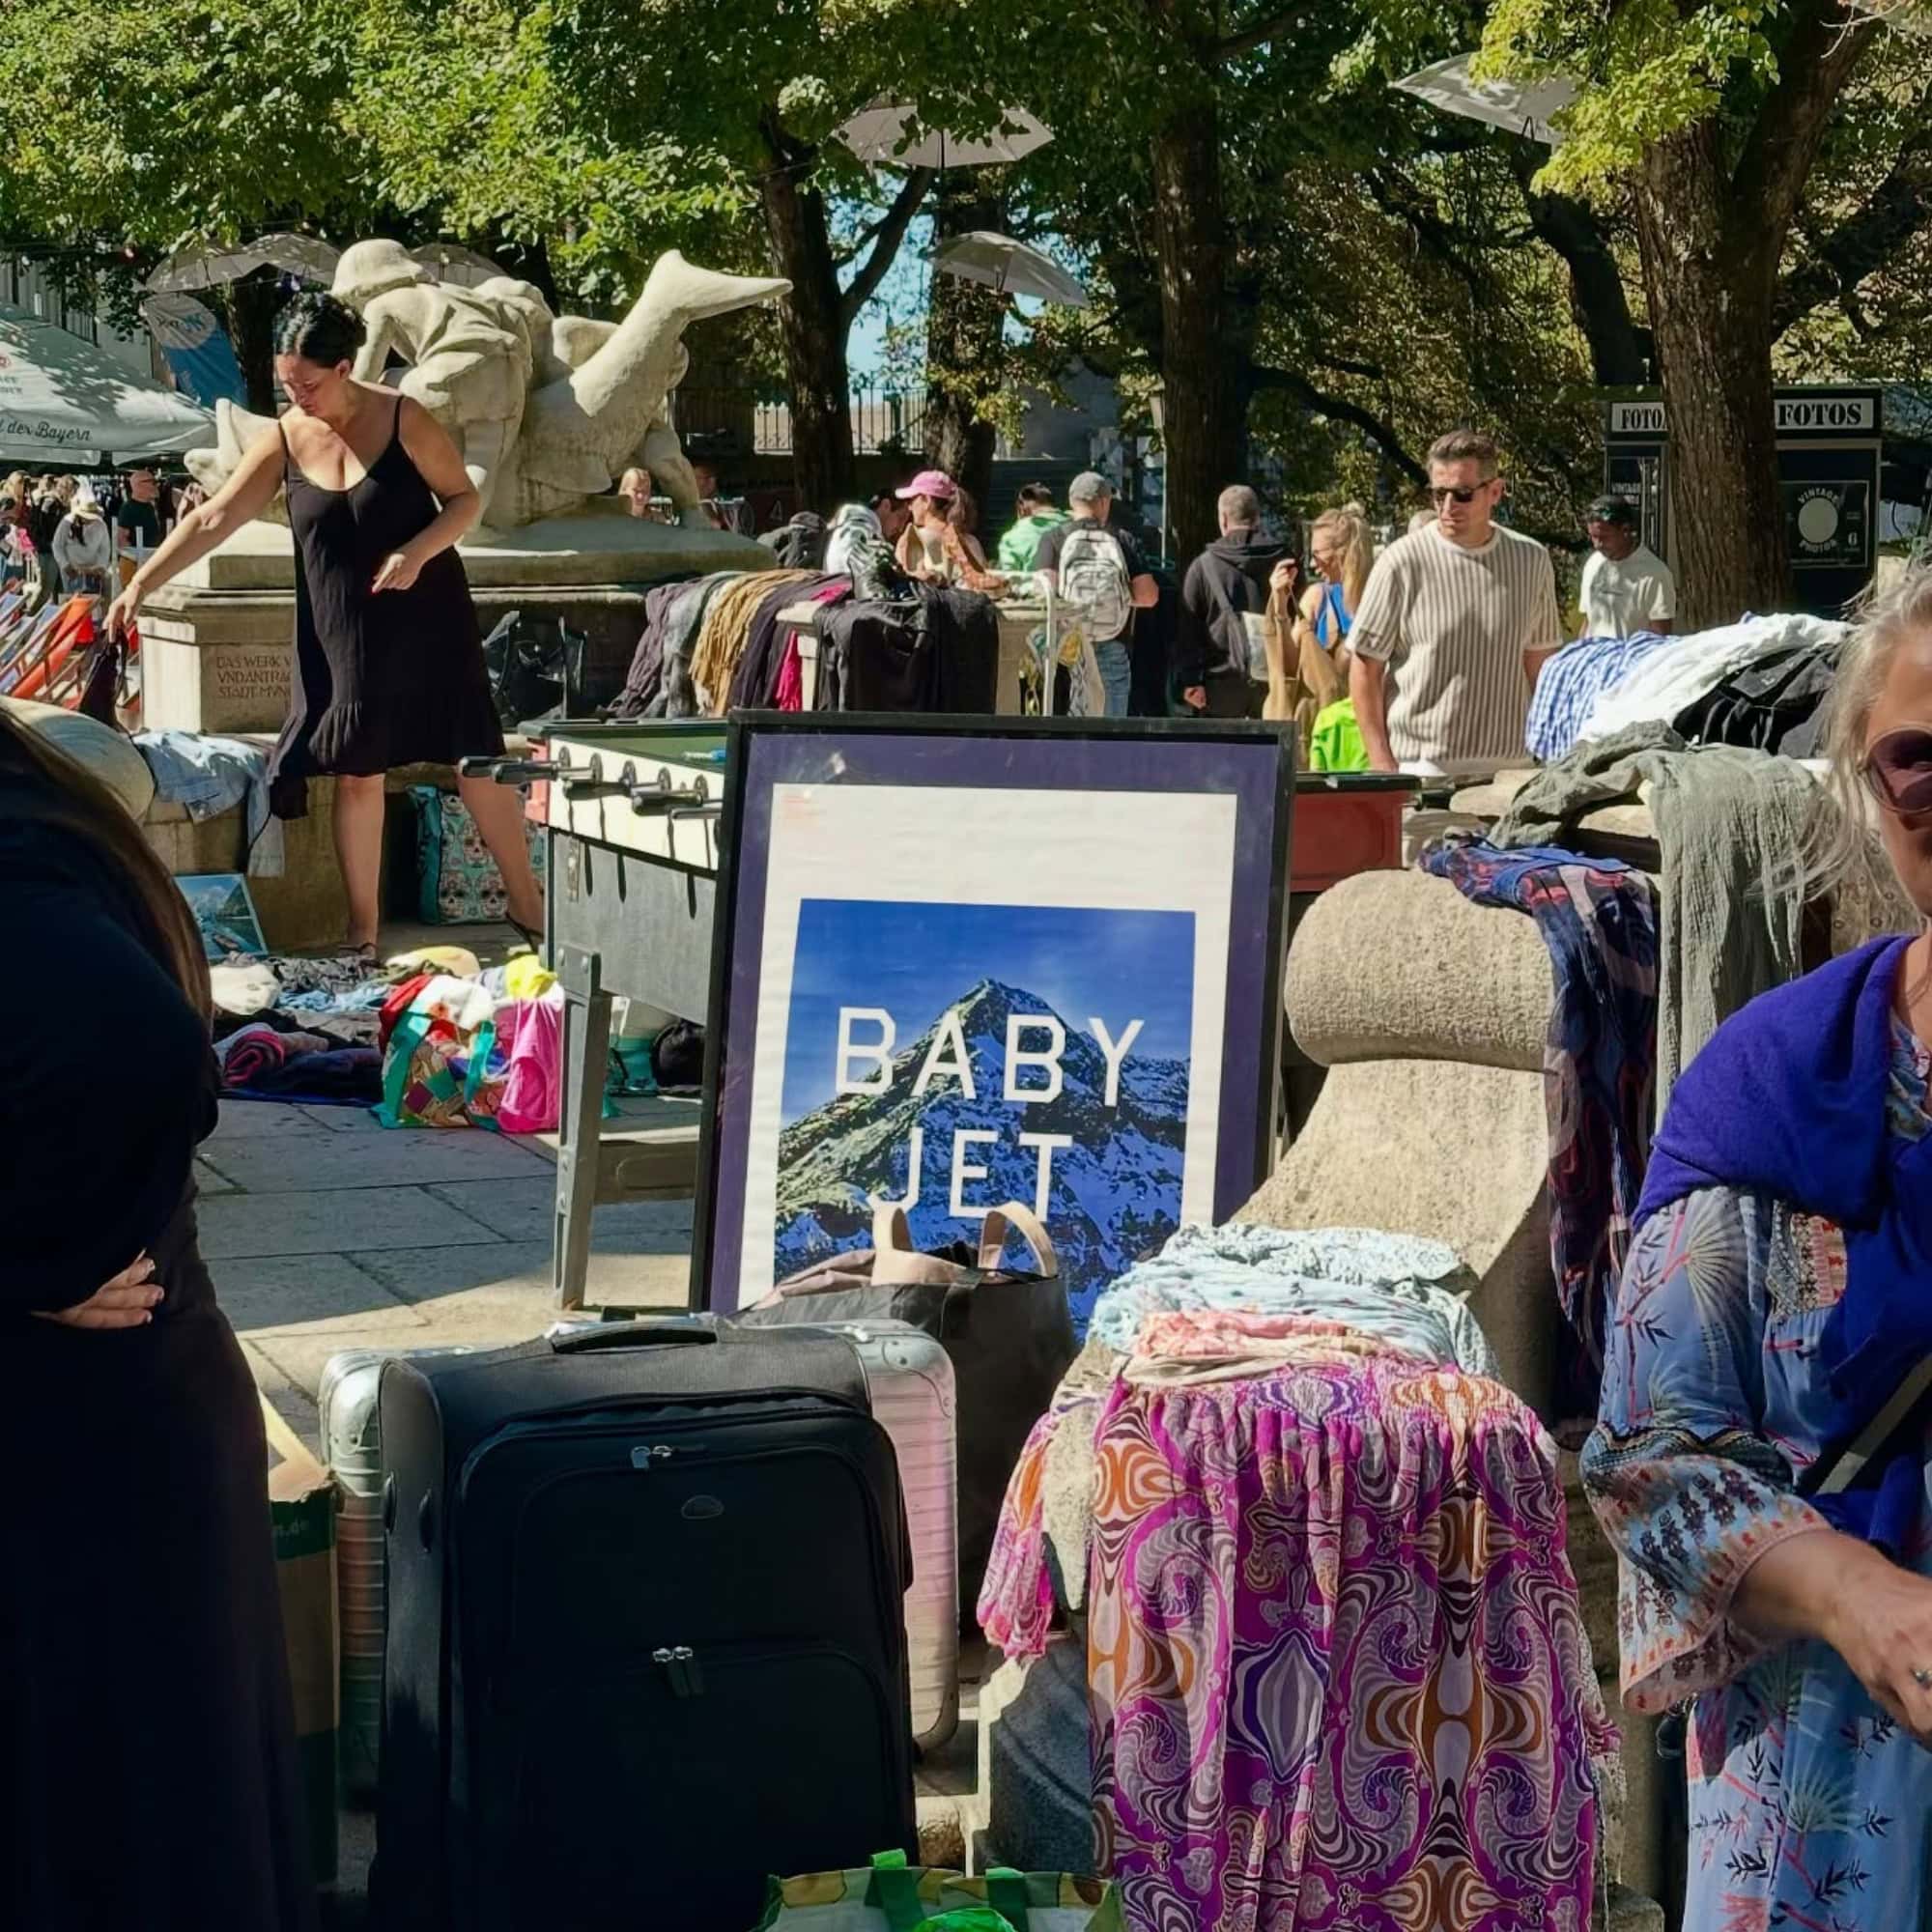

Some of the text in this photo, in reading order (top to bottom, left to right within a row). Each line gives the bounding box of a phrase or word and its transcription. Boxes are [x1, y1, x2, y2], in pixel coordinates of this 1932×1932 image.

[1621, 408, 1669, 430] FOTO
[1777, 402, 1862, 426] FOTOS
[34, 420, 91, 444] Bayern
[216, 656, 242, 668] DAS
[243, 655, 280, 668] WERK
[835, 1006, 1145, 1108] BABY
[867, 1126, 1072, 1223] JET
